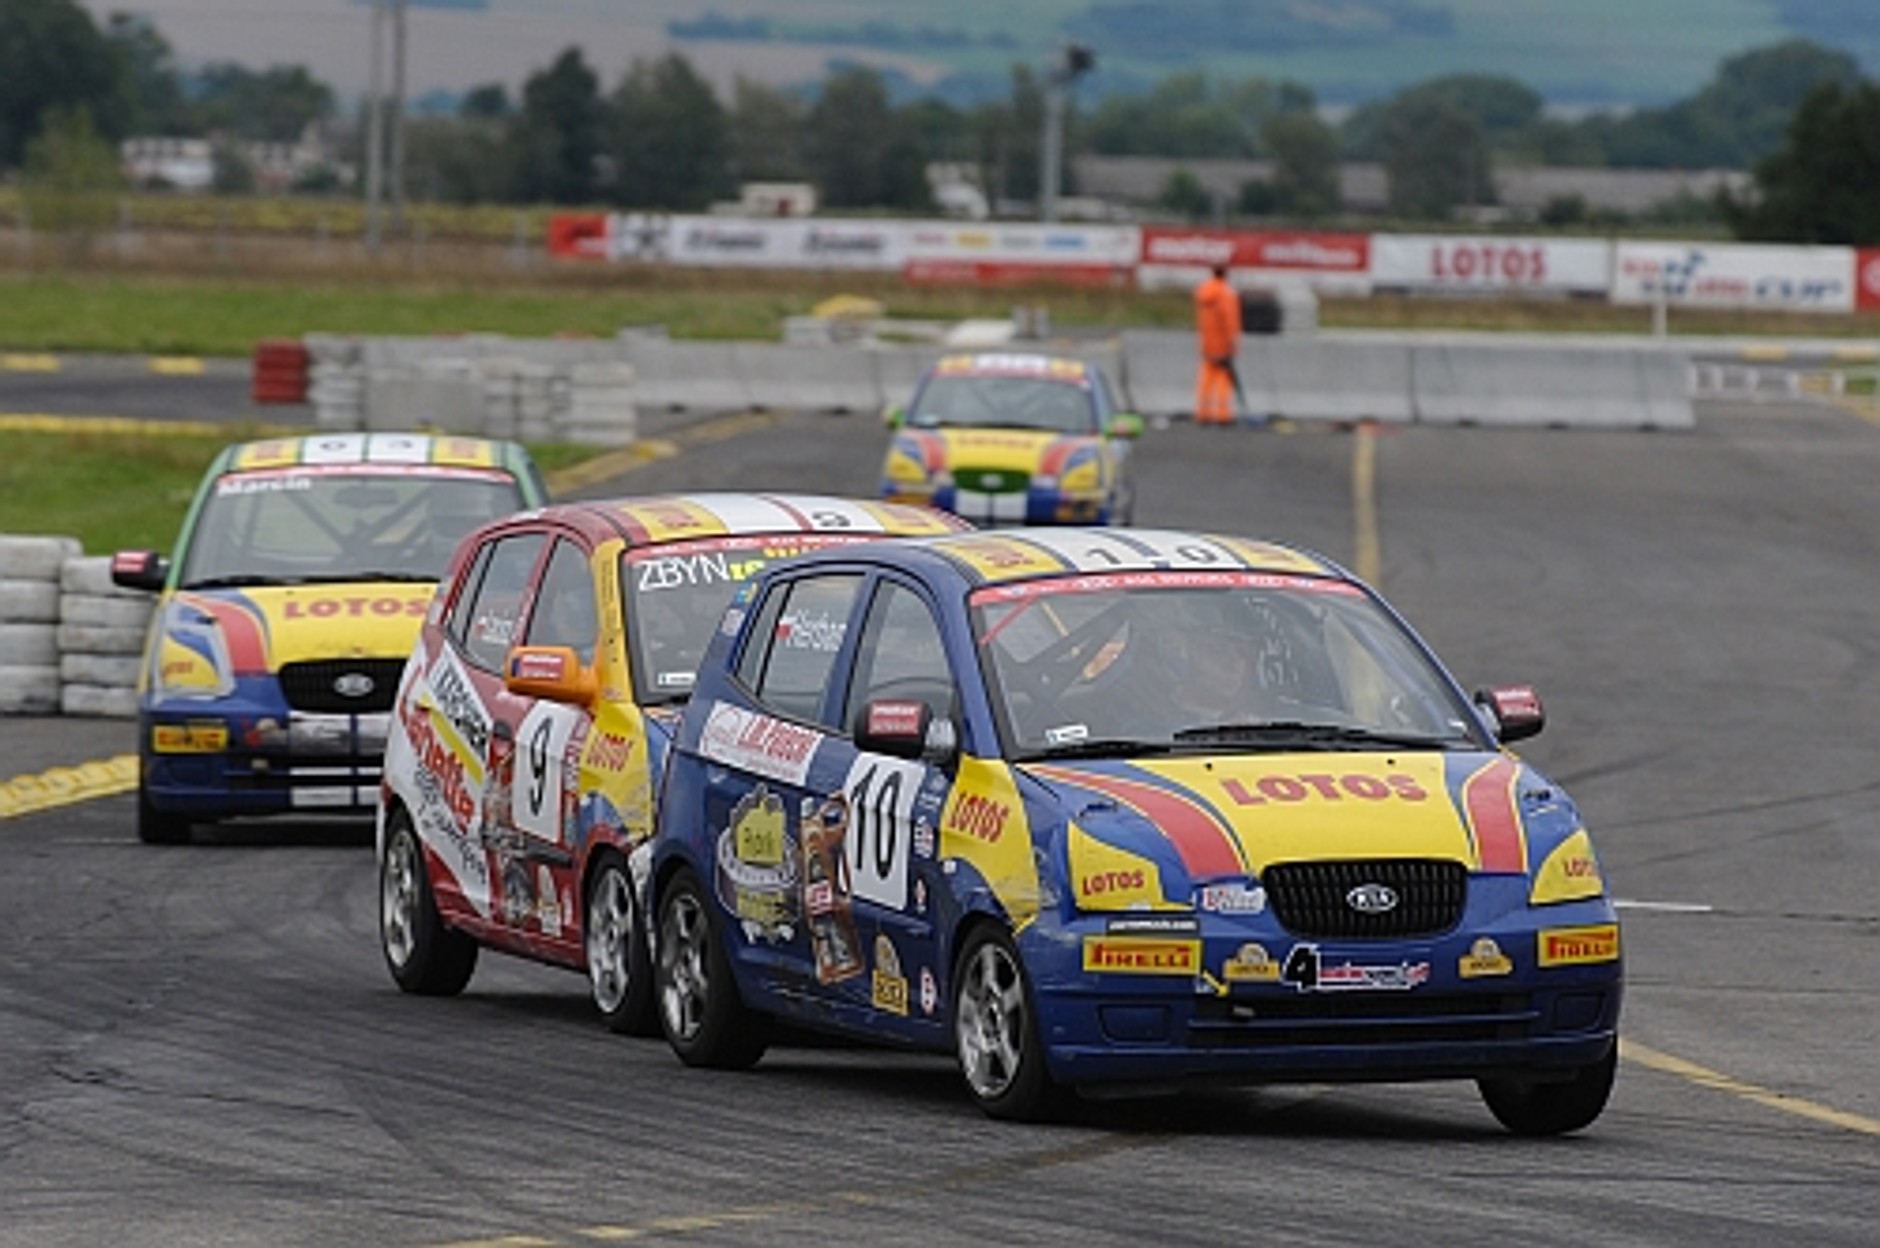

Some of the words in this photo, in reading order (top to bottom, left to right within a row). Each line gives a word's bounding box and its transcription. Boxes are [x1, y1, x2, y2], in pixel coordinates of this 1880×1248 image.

[1431, 245, 1546, 279] LOTOS
[638, 552, 731, 592] ZBYN
[284, 597, 427, 619] LOTOS
[528, 715, 554, 817] 9
[1222, 772, 1428, 806] LOTOS
[850, 762, 903, 878] 10
[950, 789, 1010, 843] LOTOS
[1082, 870, 1146, 896] LOTOS
[1090, 943, 1192, 969] PIRELLI
